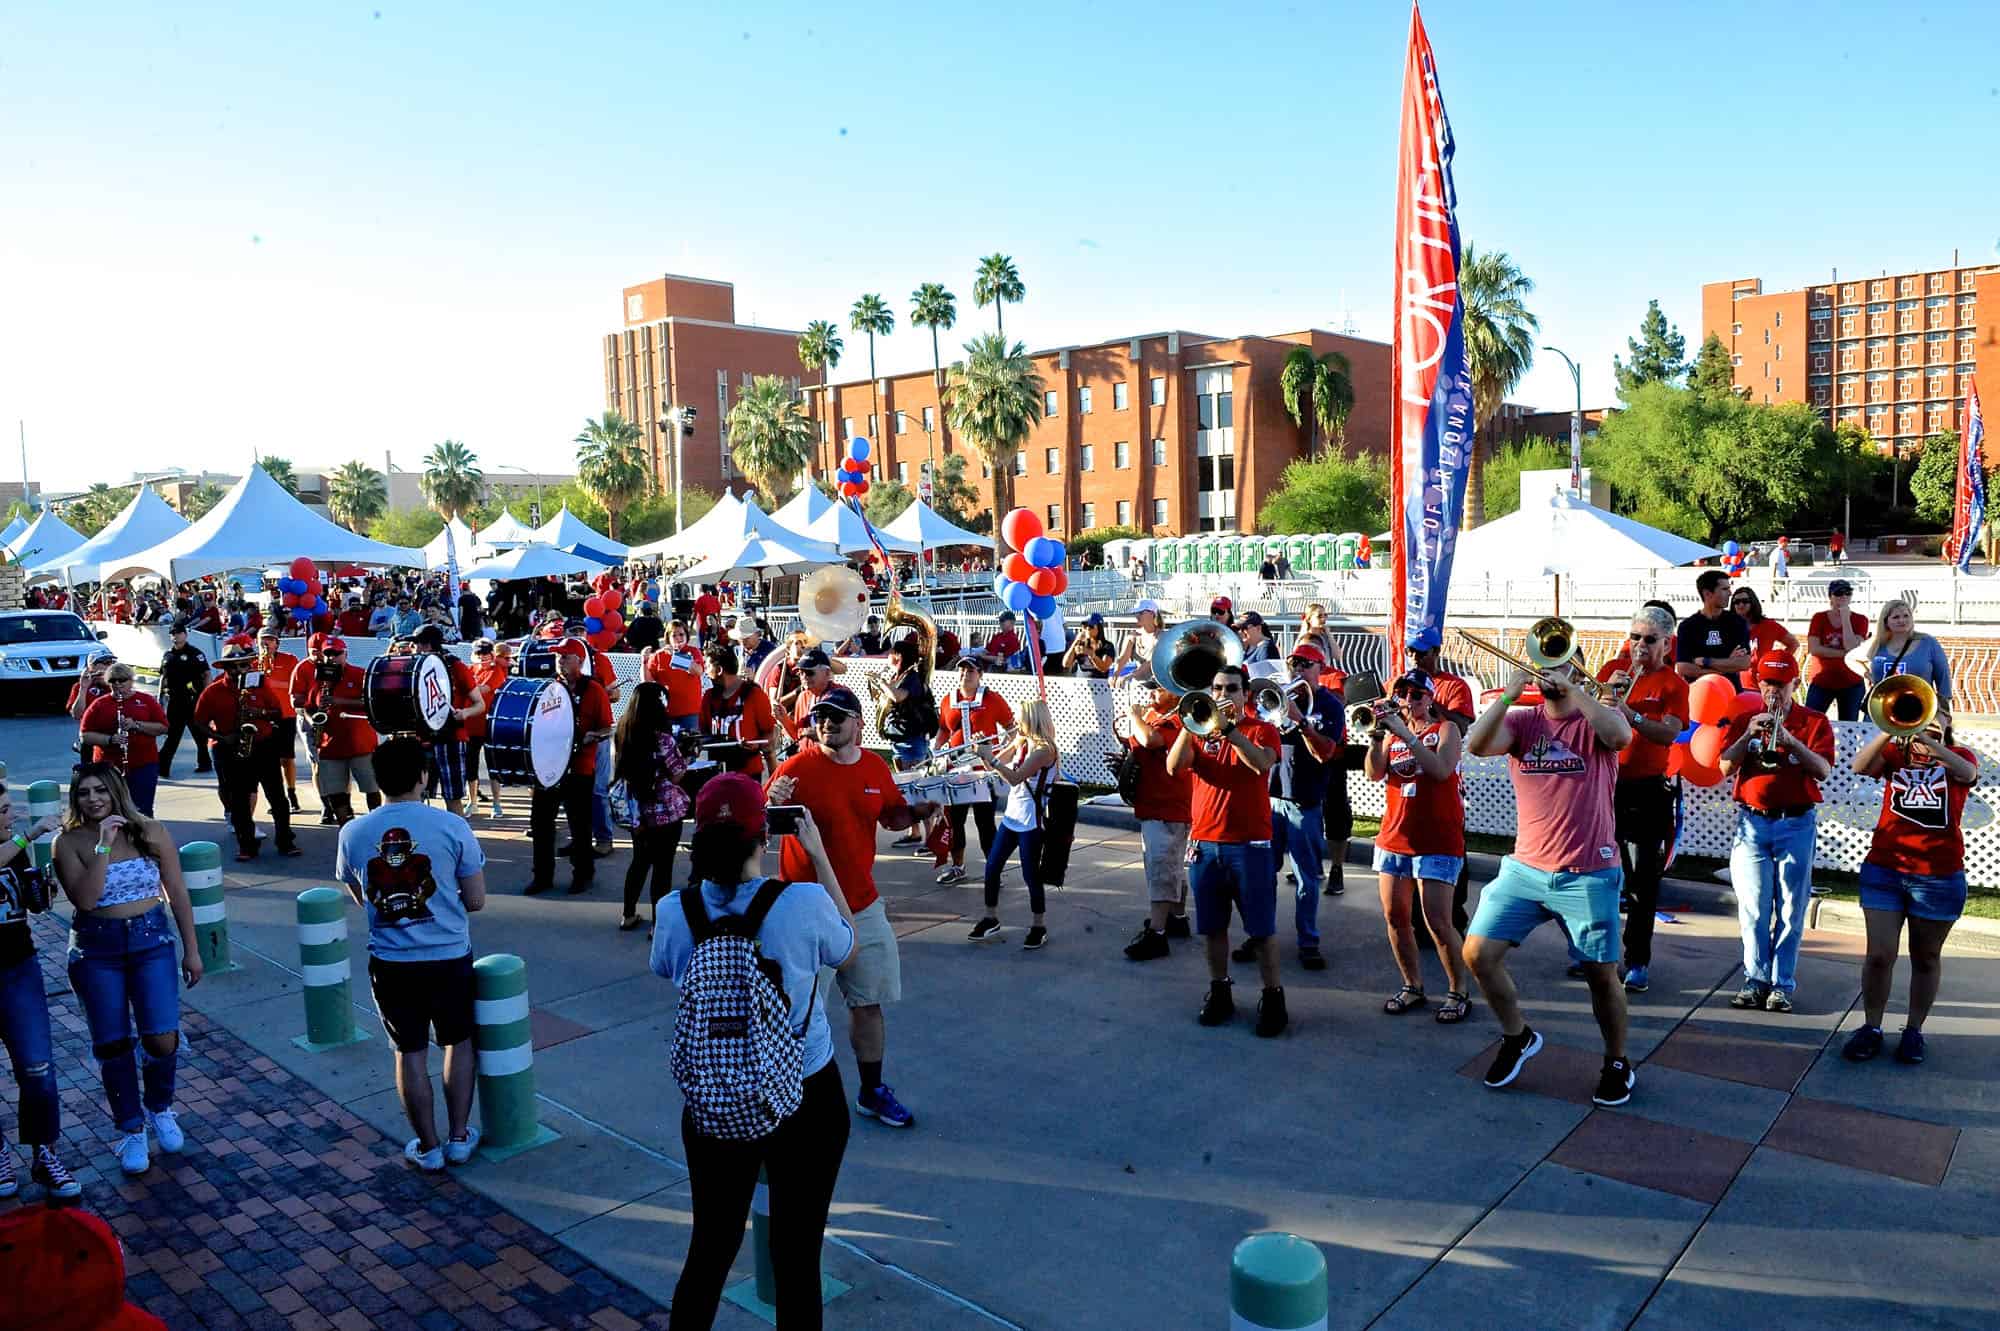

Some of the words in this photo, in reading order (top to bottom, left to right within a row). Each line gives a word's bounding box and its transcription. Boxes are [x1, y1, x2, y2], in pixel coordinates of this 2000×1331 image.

[1431, 403, 1469, 494] ARIZONA
[1423, 503, 1442, 529] OF
[424, 667, 447, 719] A
[1900, 780, 1942, 809] A
